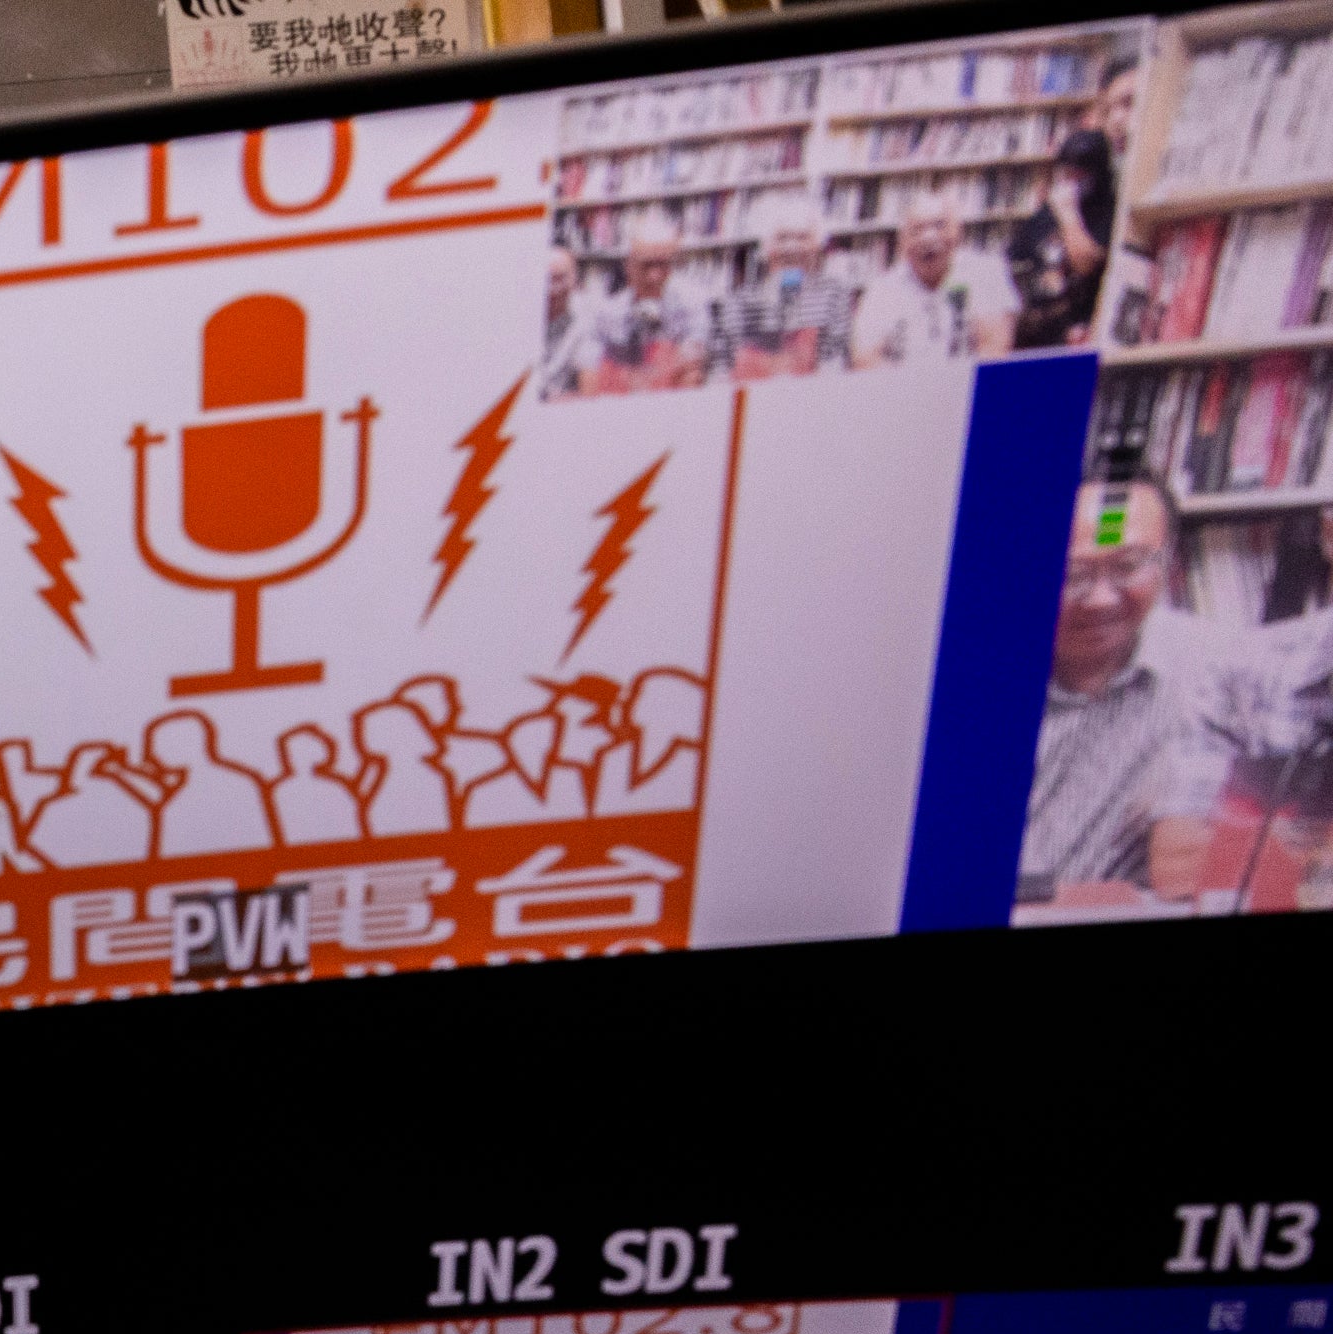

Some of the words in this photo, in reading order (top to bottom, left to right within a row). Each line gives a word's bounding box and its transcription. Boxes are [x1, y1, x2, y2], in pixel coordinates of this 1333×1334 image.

[171, 890, 308, 976] PVW
[428, 1236, 558, 1306] IN2
[601, 1224, 738, 1295] SDI
[1165, 1202, 1318, 1272] IN3
